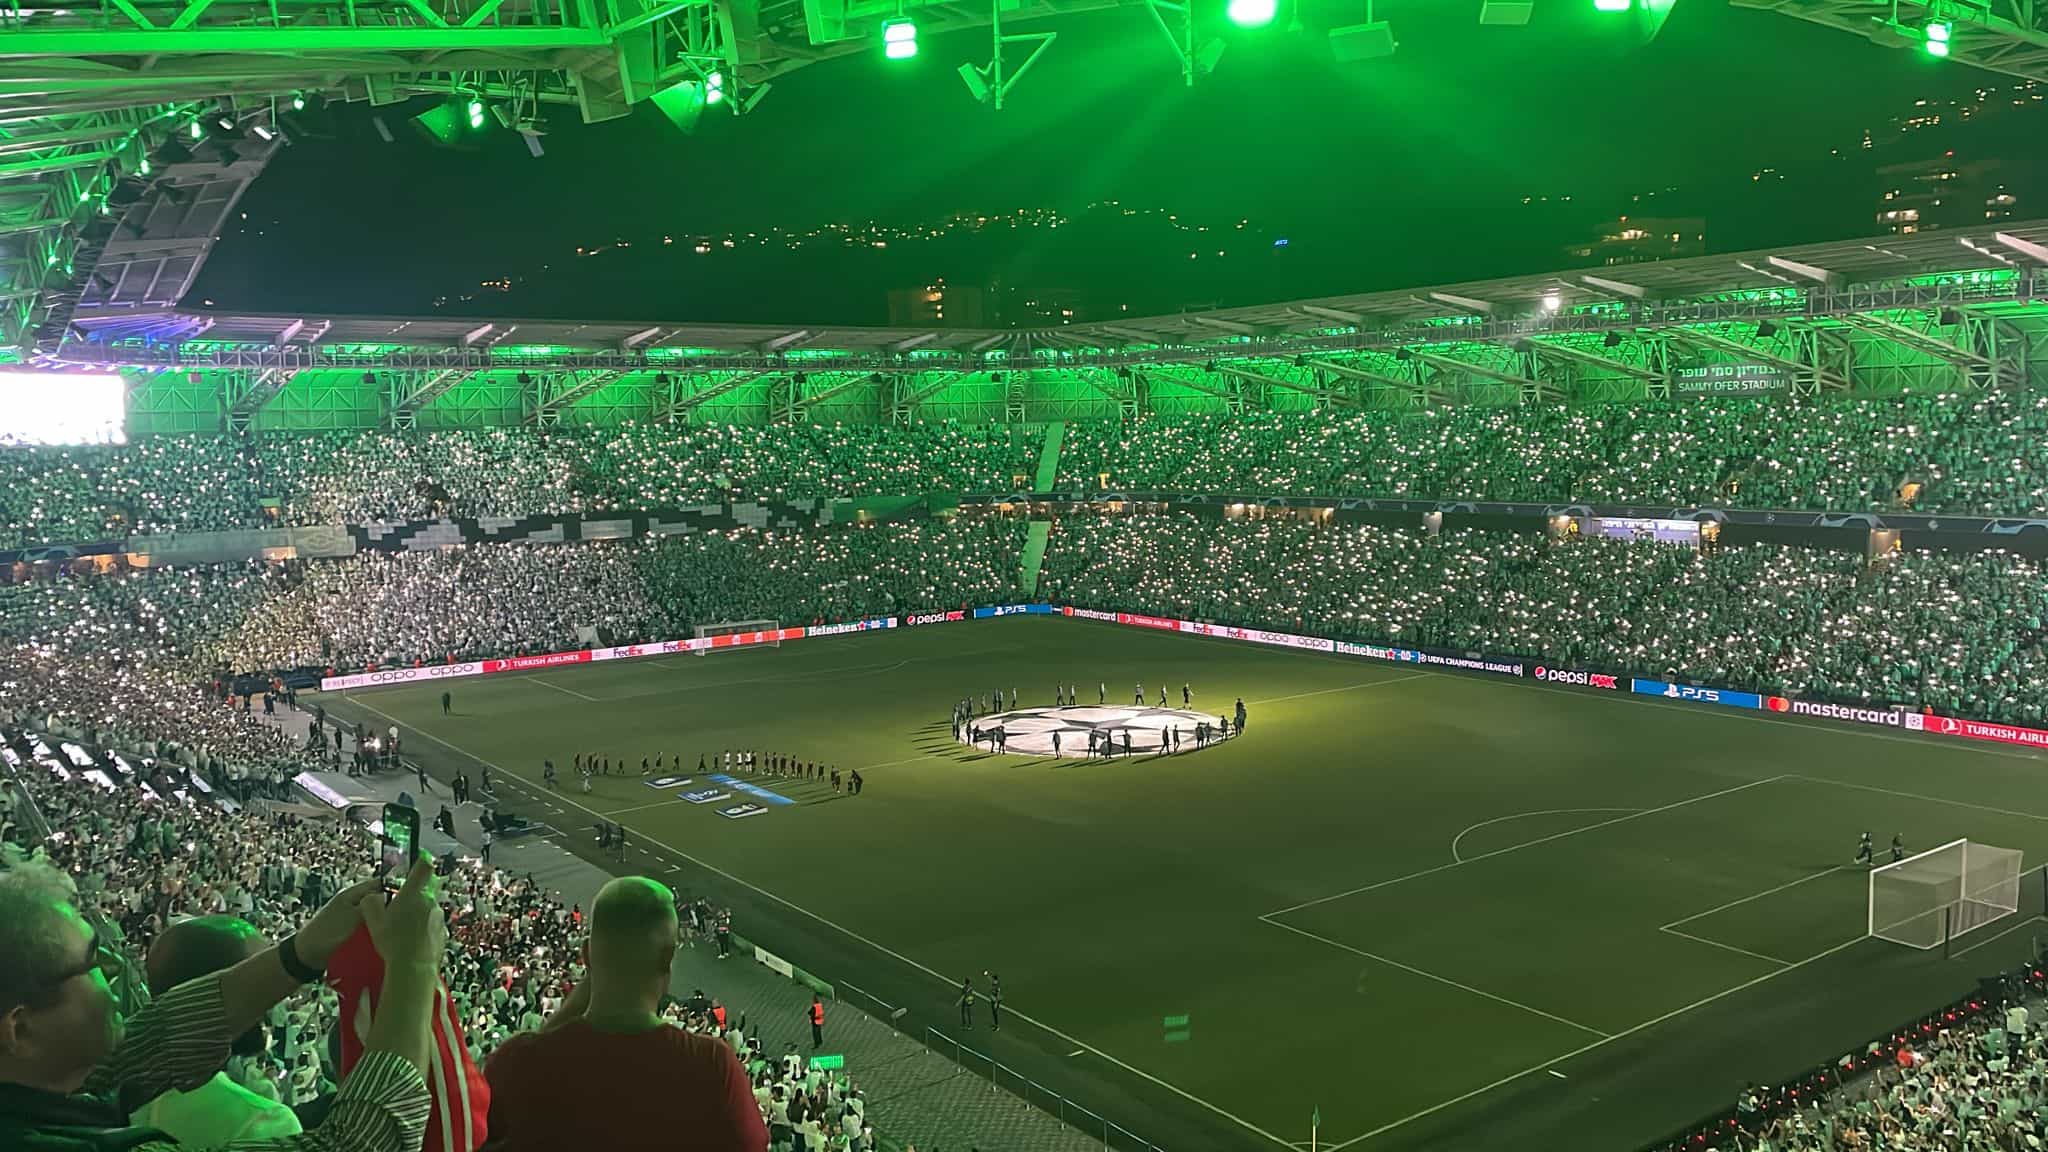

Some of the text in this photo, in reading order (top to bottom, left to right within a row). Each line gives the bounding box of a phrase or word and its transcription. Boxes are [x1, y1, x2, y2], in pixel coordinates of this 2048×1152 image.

[1678, 379, 1785, 392] SAMMY OFER STADIUM
[1005, 605, 1027, 613] PS5
[1074, 608, 1116, 621] mastercard
[917, 612, 944, 624] pepsi
[808, 623, 857, 636] Heineken
[1193, 623, 1248, 639] FedEx FedEx
[613, 640, 691, 657] FedEx FedEx
[1336, 641, 1386, 658] Heineken
[512, 654, 579, 667] TURKISH AIRLINES
[1427, 655, 1512, 673] UEFA CHAMPIONS LEAGUE
[1548, 669, 1587, 685] pepsi
[1682, 687, 1719, 701] PS5
[1793, 700, 1899, 726] mastercard
[1966, 724, 2016, 740] TURKISH
